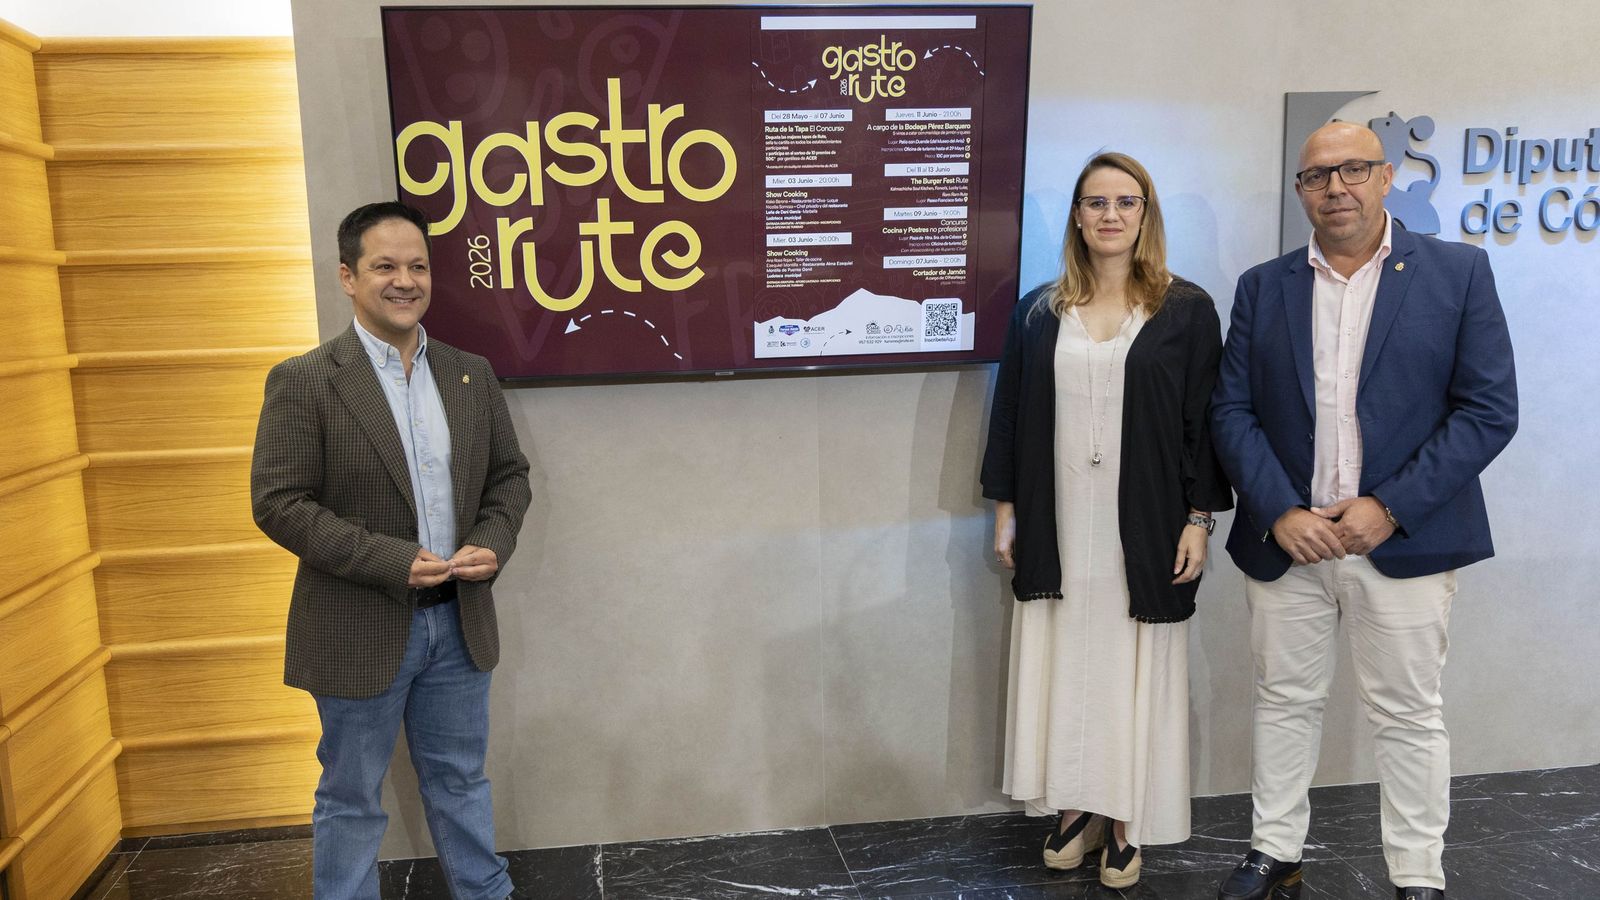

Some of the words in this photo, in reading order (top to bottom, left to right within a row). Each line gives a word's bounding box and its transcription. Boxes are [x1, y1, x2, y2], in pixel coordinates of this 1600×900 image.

[822, 34, 916, 80] gastro
[848, 68, 906, 102] rute
[794, 126, 808, 134] Tapa
[396, 78, 737, 236] gastro
[923, 178, 942, 186] Burger
[1461, 188, 1523, 234] de
[1538, 185, 1600, 234] Có
[468, 234, 493, 288] 2026
[496, 198, 705, 312] rute
